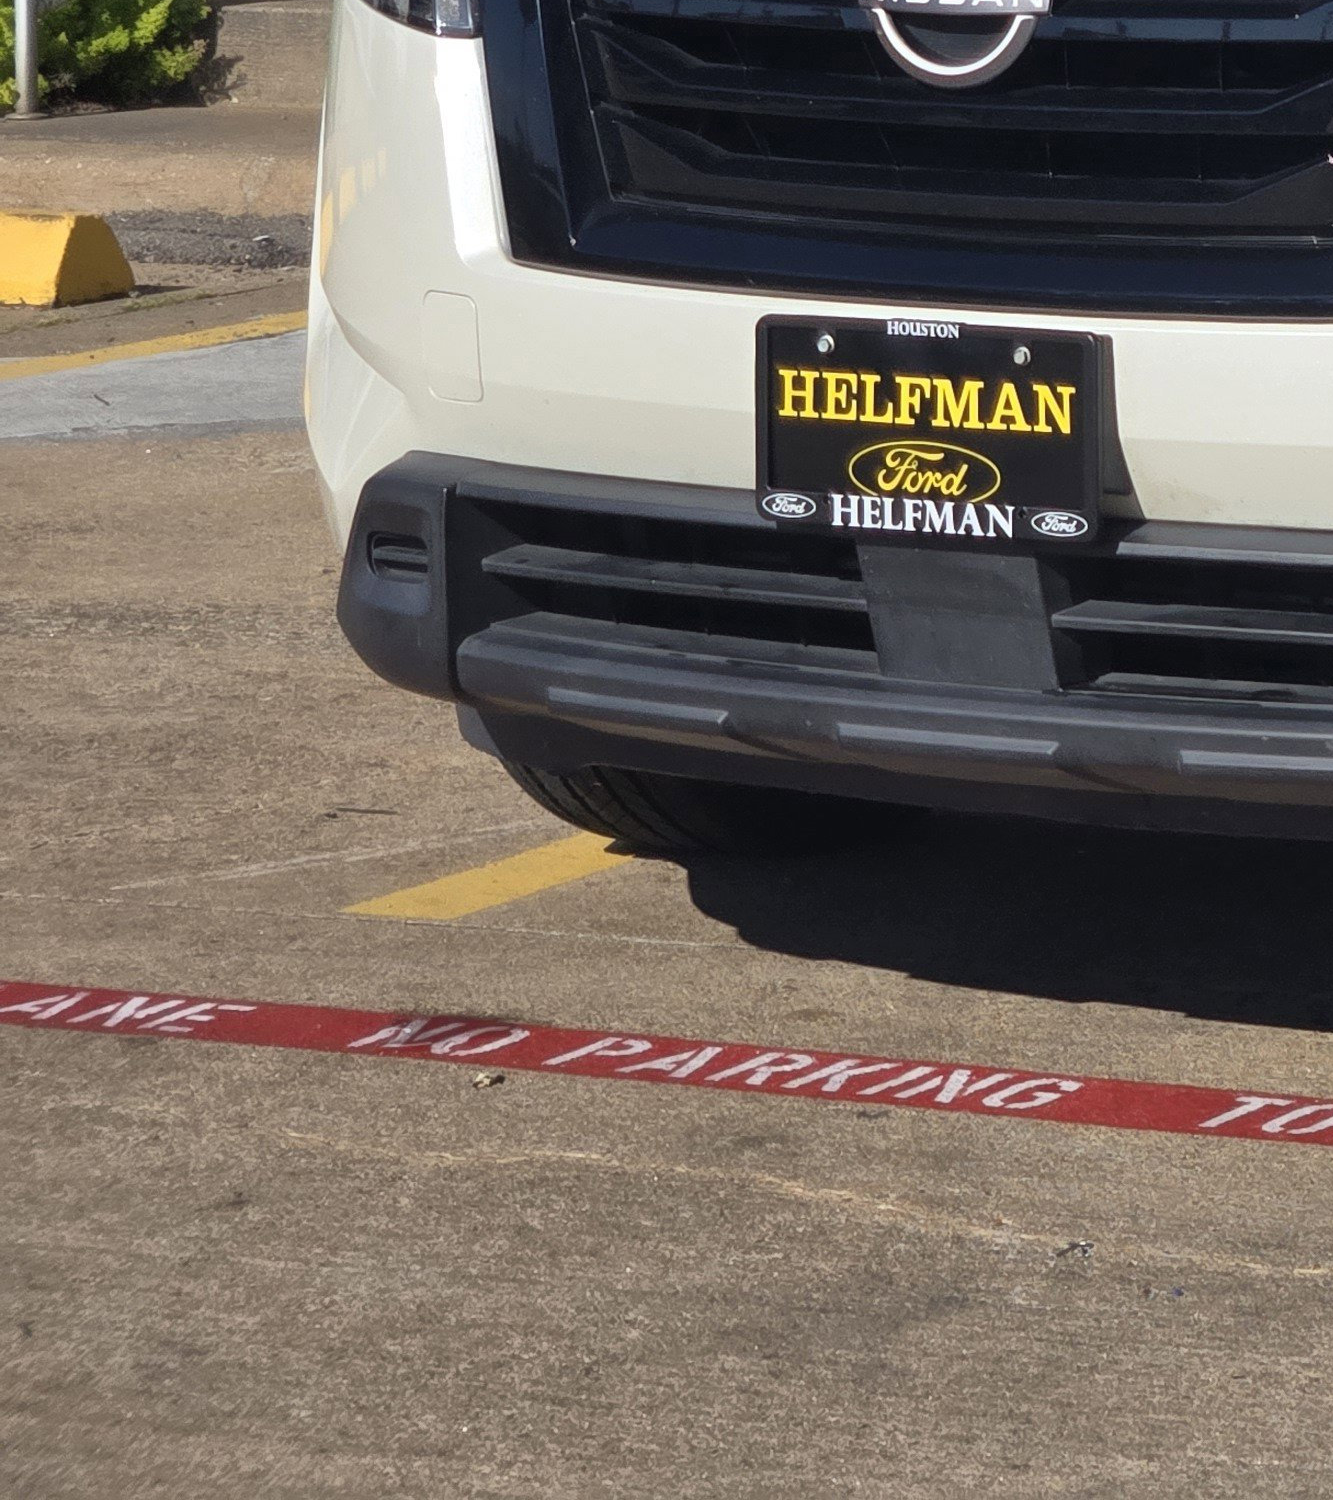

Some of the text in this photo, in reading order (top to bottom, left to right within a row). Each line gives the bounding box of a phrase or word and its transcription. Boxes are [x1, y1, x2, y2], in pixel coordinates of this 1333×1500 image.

[886, 320, 960, 339] HOUSTON
[778, 368, 1076, 435] HELFMAN
[877, 447, 969, 497] Ford
[770, 492, 1078, 538] Ford HELFMAN Ford
[0, 991, 257, 1032] ANE
[347, 1017, 531, 1058] NO
[542, 1035, 1083, 1110] PARKING
